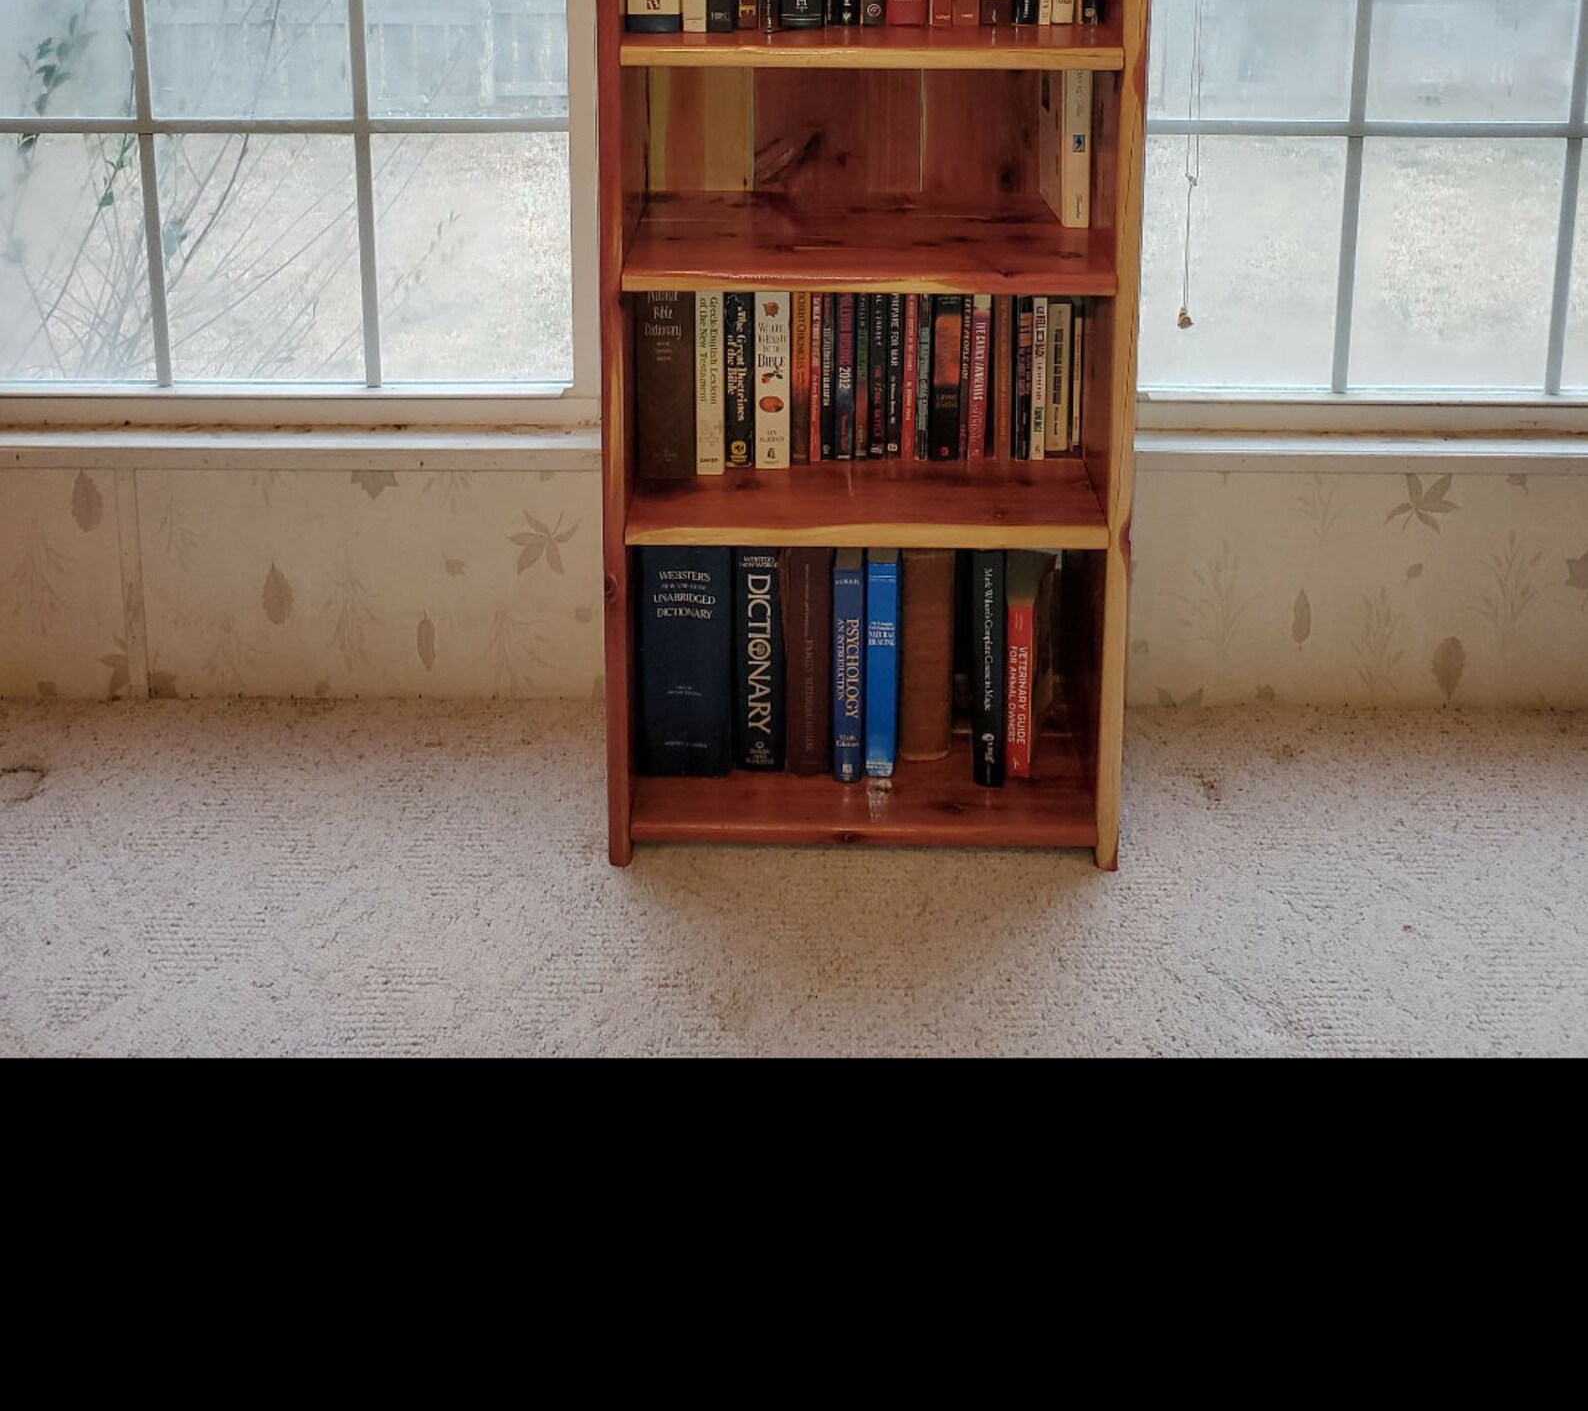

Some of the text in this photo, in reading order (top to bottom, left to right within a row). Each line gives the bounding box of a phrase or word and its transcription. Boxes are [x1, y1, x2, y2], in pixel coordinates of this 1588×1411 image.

[699, 297, 709, 402] of the New Testament
[736, 334, 747, 367] Great
[891, 330, 899, 346] FOR
[891, 348, 899, 366] WAR
[962, 329, 970, 361] PEOPLE
[726, 334, 737, 395] of the Bible
[757, 353, 786, 368] BIBLE
[838, 366, 851, 389] 2012
[709, 367, 719, 405] Lexicon
[736, 368, 748, 422] Doctrines
[658, 571, 711, 582] WEBSTER'S
[653, 593, 716, 605] UNABRIDGED
[656, 607, 713, 619] DICTIONARY
[748, 574, 771, 734] DICTIONARY
[982, 568, 994, 712] Mark Wilson's Complete Course in Magic
[836, 618, 845, 701] AN INTRODUCTION
[845, 619, 860, 719] PSYCHOLOGY
[1008, 645, 1017, 743] FOR ANIMAL OWNERS
[1016, 646, 1029, 745] VETERINARY GUIDE
